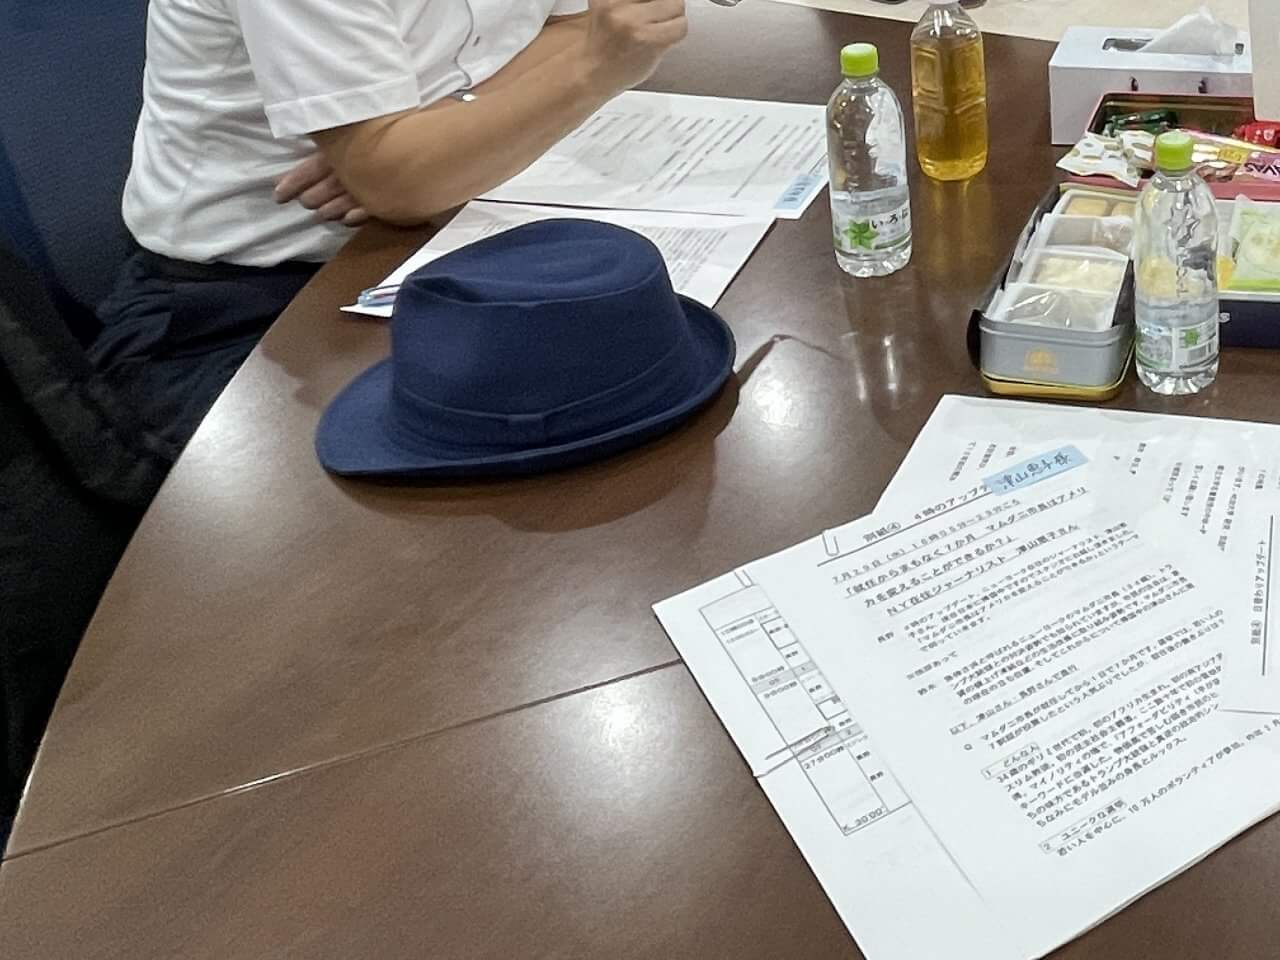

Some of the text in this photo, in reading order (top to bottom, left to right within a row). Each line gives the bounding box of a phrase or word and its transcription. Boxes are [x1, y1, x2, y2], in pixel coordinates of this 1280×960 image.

[883, 554, 1008, 616] NY在住ジャーナリスト
[1251, 539, 1266, 612] 日替わりアップデート
